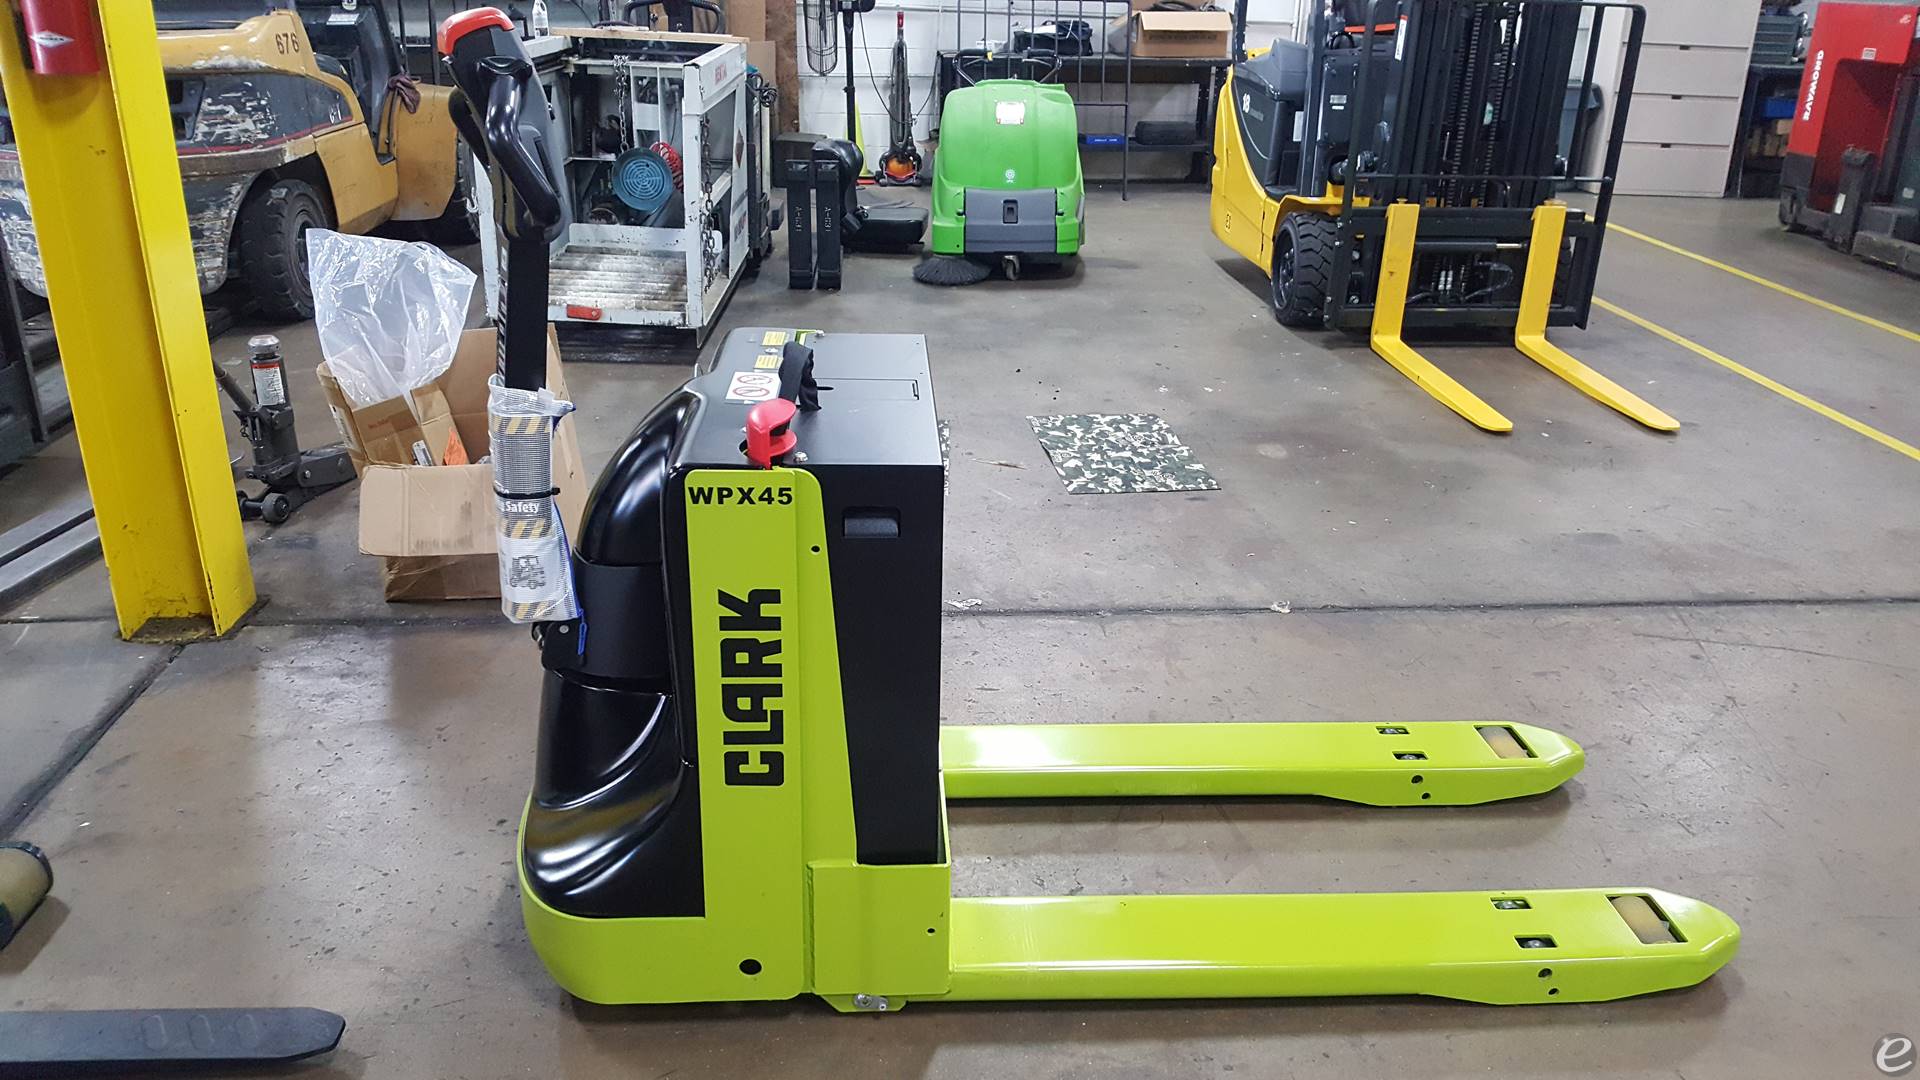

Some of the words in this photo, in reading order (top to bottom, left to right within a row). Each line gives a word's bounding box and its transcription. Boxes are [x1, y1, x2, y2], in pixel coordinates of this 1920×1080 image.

[275, 31, 300, 55] 676
[1802, 49, 1825, 121] RAYMOND
[1242, 93, 1251, 113] 18
[505, 500, 540, 514] Safety
[687, 486, 794, 506] WPX45
[717, 587, 785, 787] CLARK
